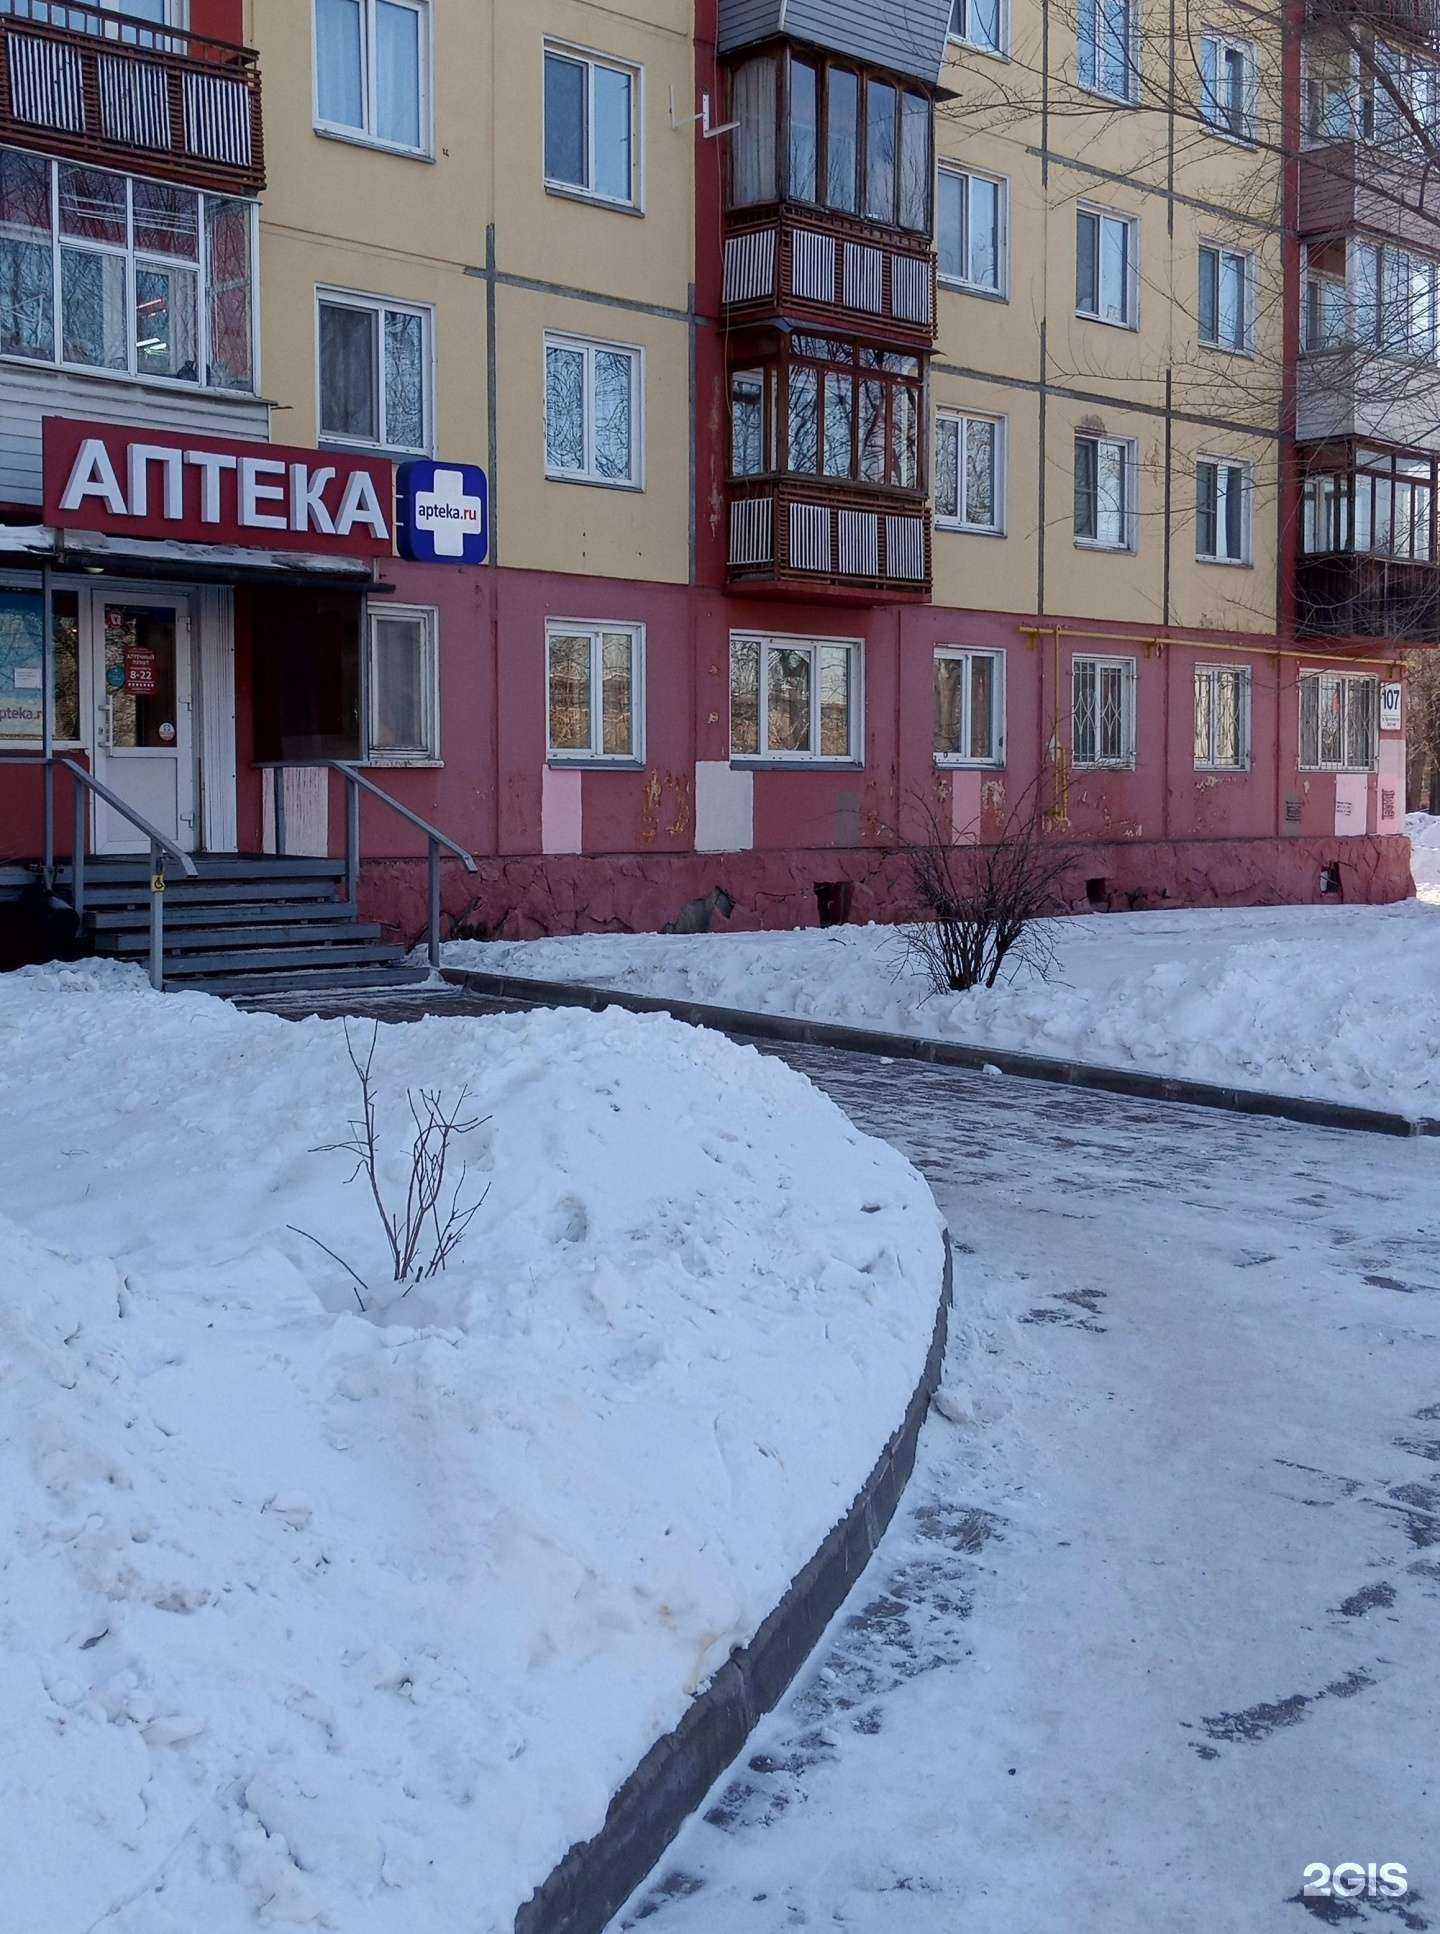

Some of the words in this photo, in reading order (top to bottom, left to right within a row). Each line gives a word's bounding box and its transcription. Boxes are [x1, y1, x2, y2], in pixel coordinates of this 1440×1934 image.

[58, 438, 390, 539] АПТЕКА
[418, 503, 477, 520] apteka.ru
[130, 670, 152, 680] 8-22
[1382, 689, 1400, 710] 107
[0, 706, 42, 721] pteka.r
